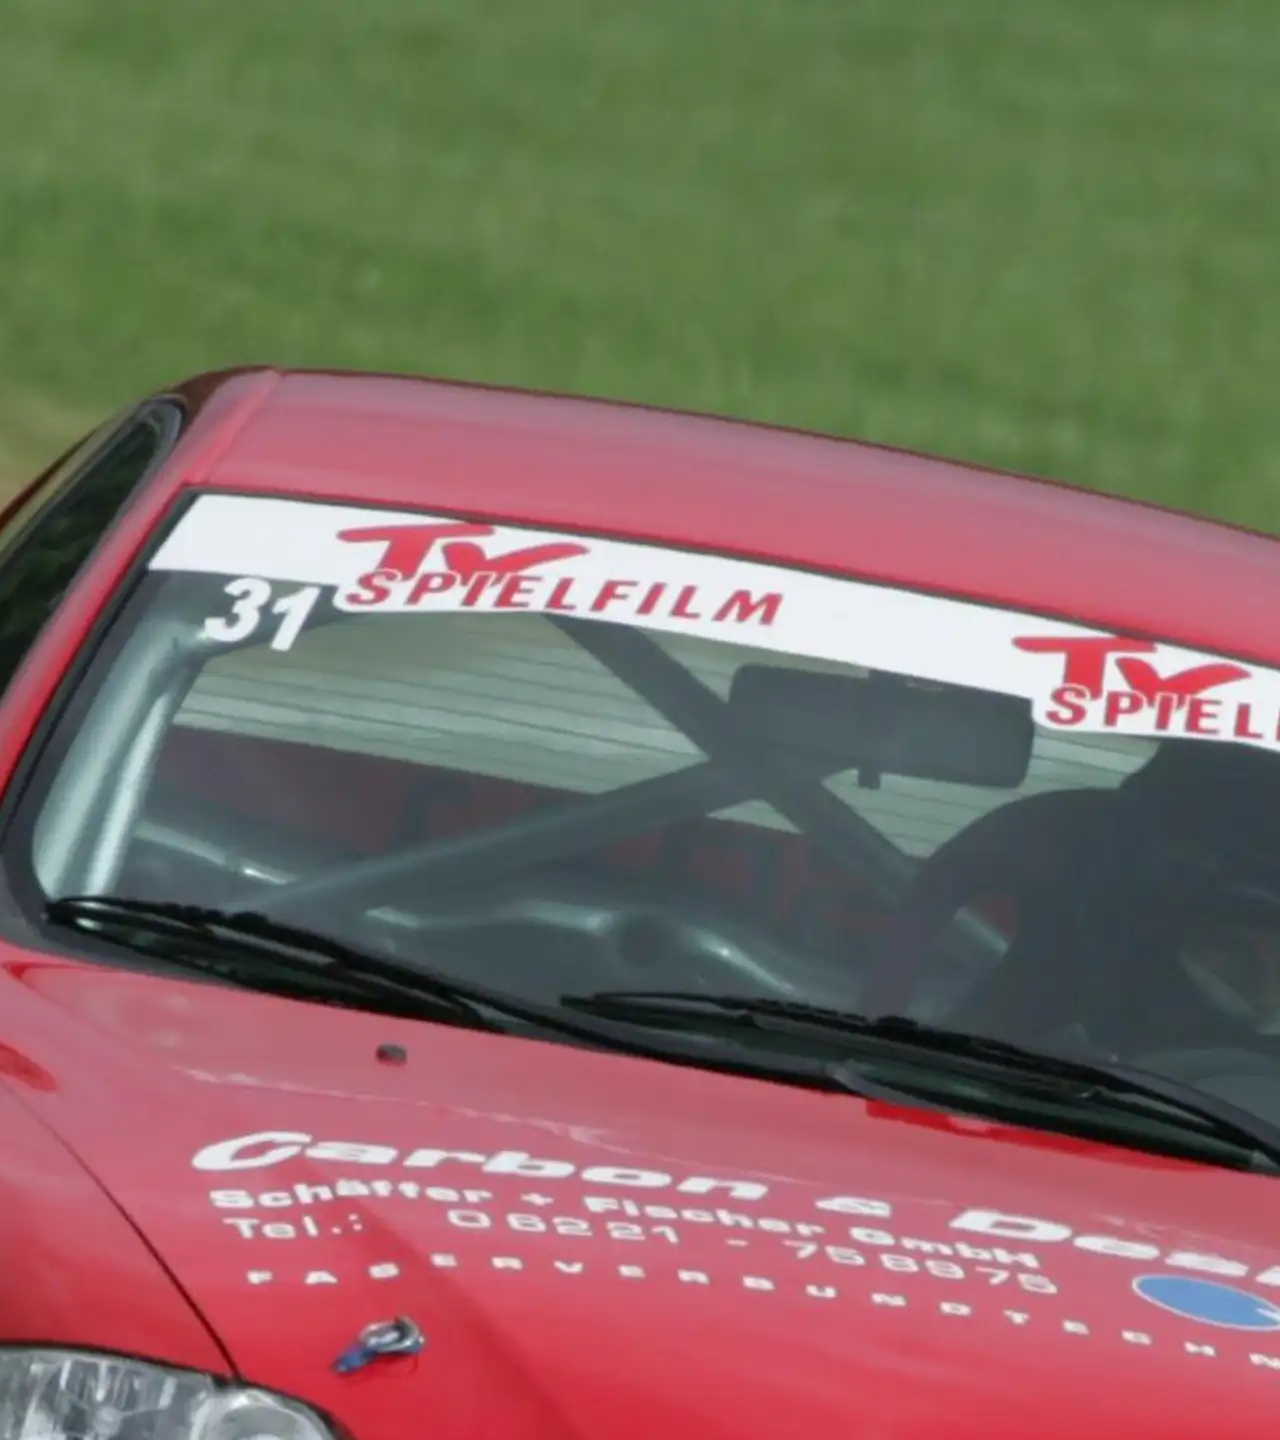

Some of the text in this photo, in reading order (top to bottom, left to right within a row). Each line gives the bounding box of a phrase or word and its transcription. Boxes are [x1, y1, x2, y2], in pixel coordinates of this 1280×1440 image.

[200, 575, 320, 652] 31
[345, 568, 784, 626] SPIELFILM
[192, 1131, 769, 1200] Carbon
[815, 1196, 892, 1218] &
[849, 1226, 1041, 1269] GmbH
